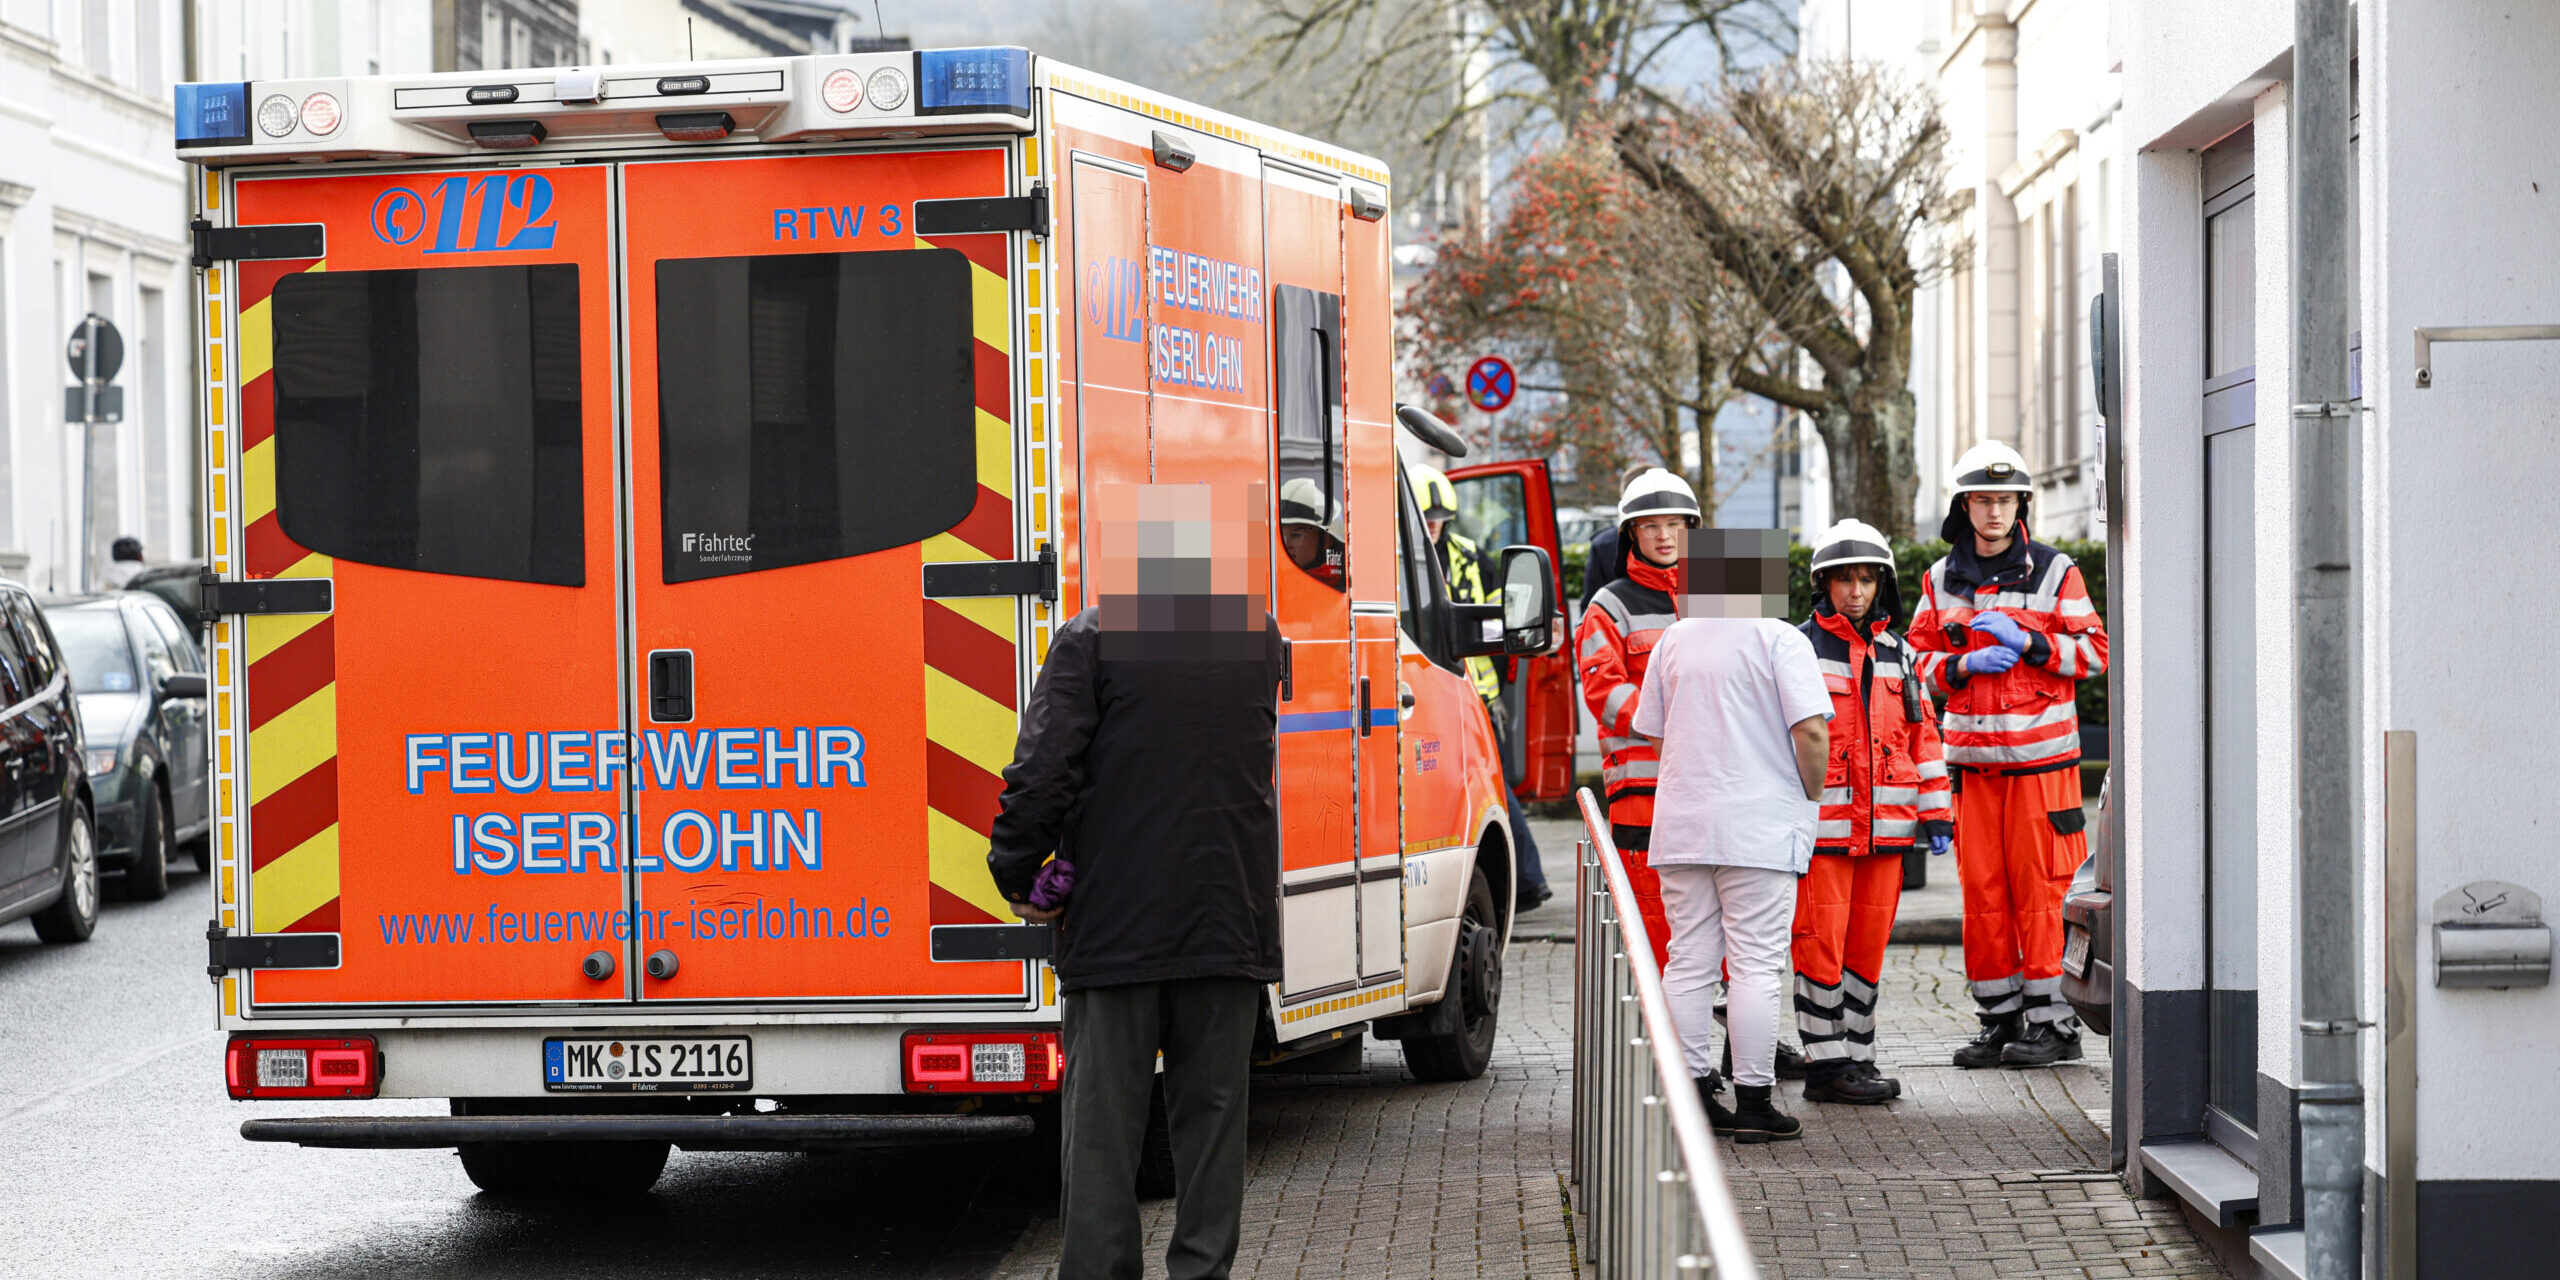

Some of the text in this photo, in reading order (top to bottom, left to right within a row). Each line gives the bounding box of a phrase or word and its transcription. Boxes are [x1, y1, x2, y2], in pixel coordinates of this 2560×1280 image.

[422, 174, 557, 254] 112
[773, 204, 901, 241] RTW 3
[1102, 255, 1143, 344] 112
[1151, 244, 1262, 324] FEUERWEHR
[1152, 322, 1243, 394] ISERLOHN
[699, 533, 752, 552] fahrtec
[699, 554, 752, 562] Sonderfahrzeuge
[405, 726, 867, 794] FEUERWEHR
[452, 808, 822, 876] ISERLOHN
[1421, 860, 1428, 887] 3
[378, 896, 890, 945] www.feuerwehr-iserlohn.de
[551, 1066, 559, 1076] D
[567, 1043, 743, 1078] MK IS 2116
[637, 1082, 658, 1091] fahrtec
